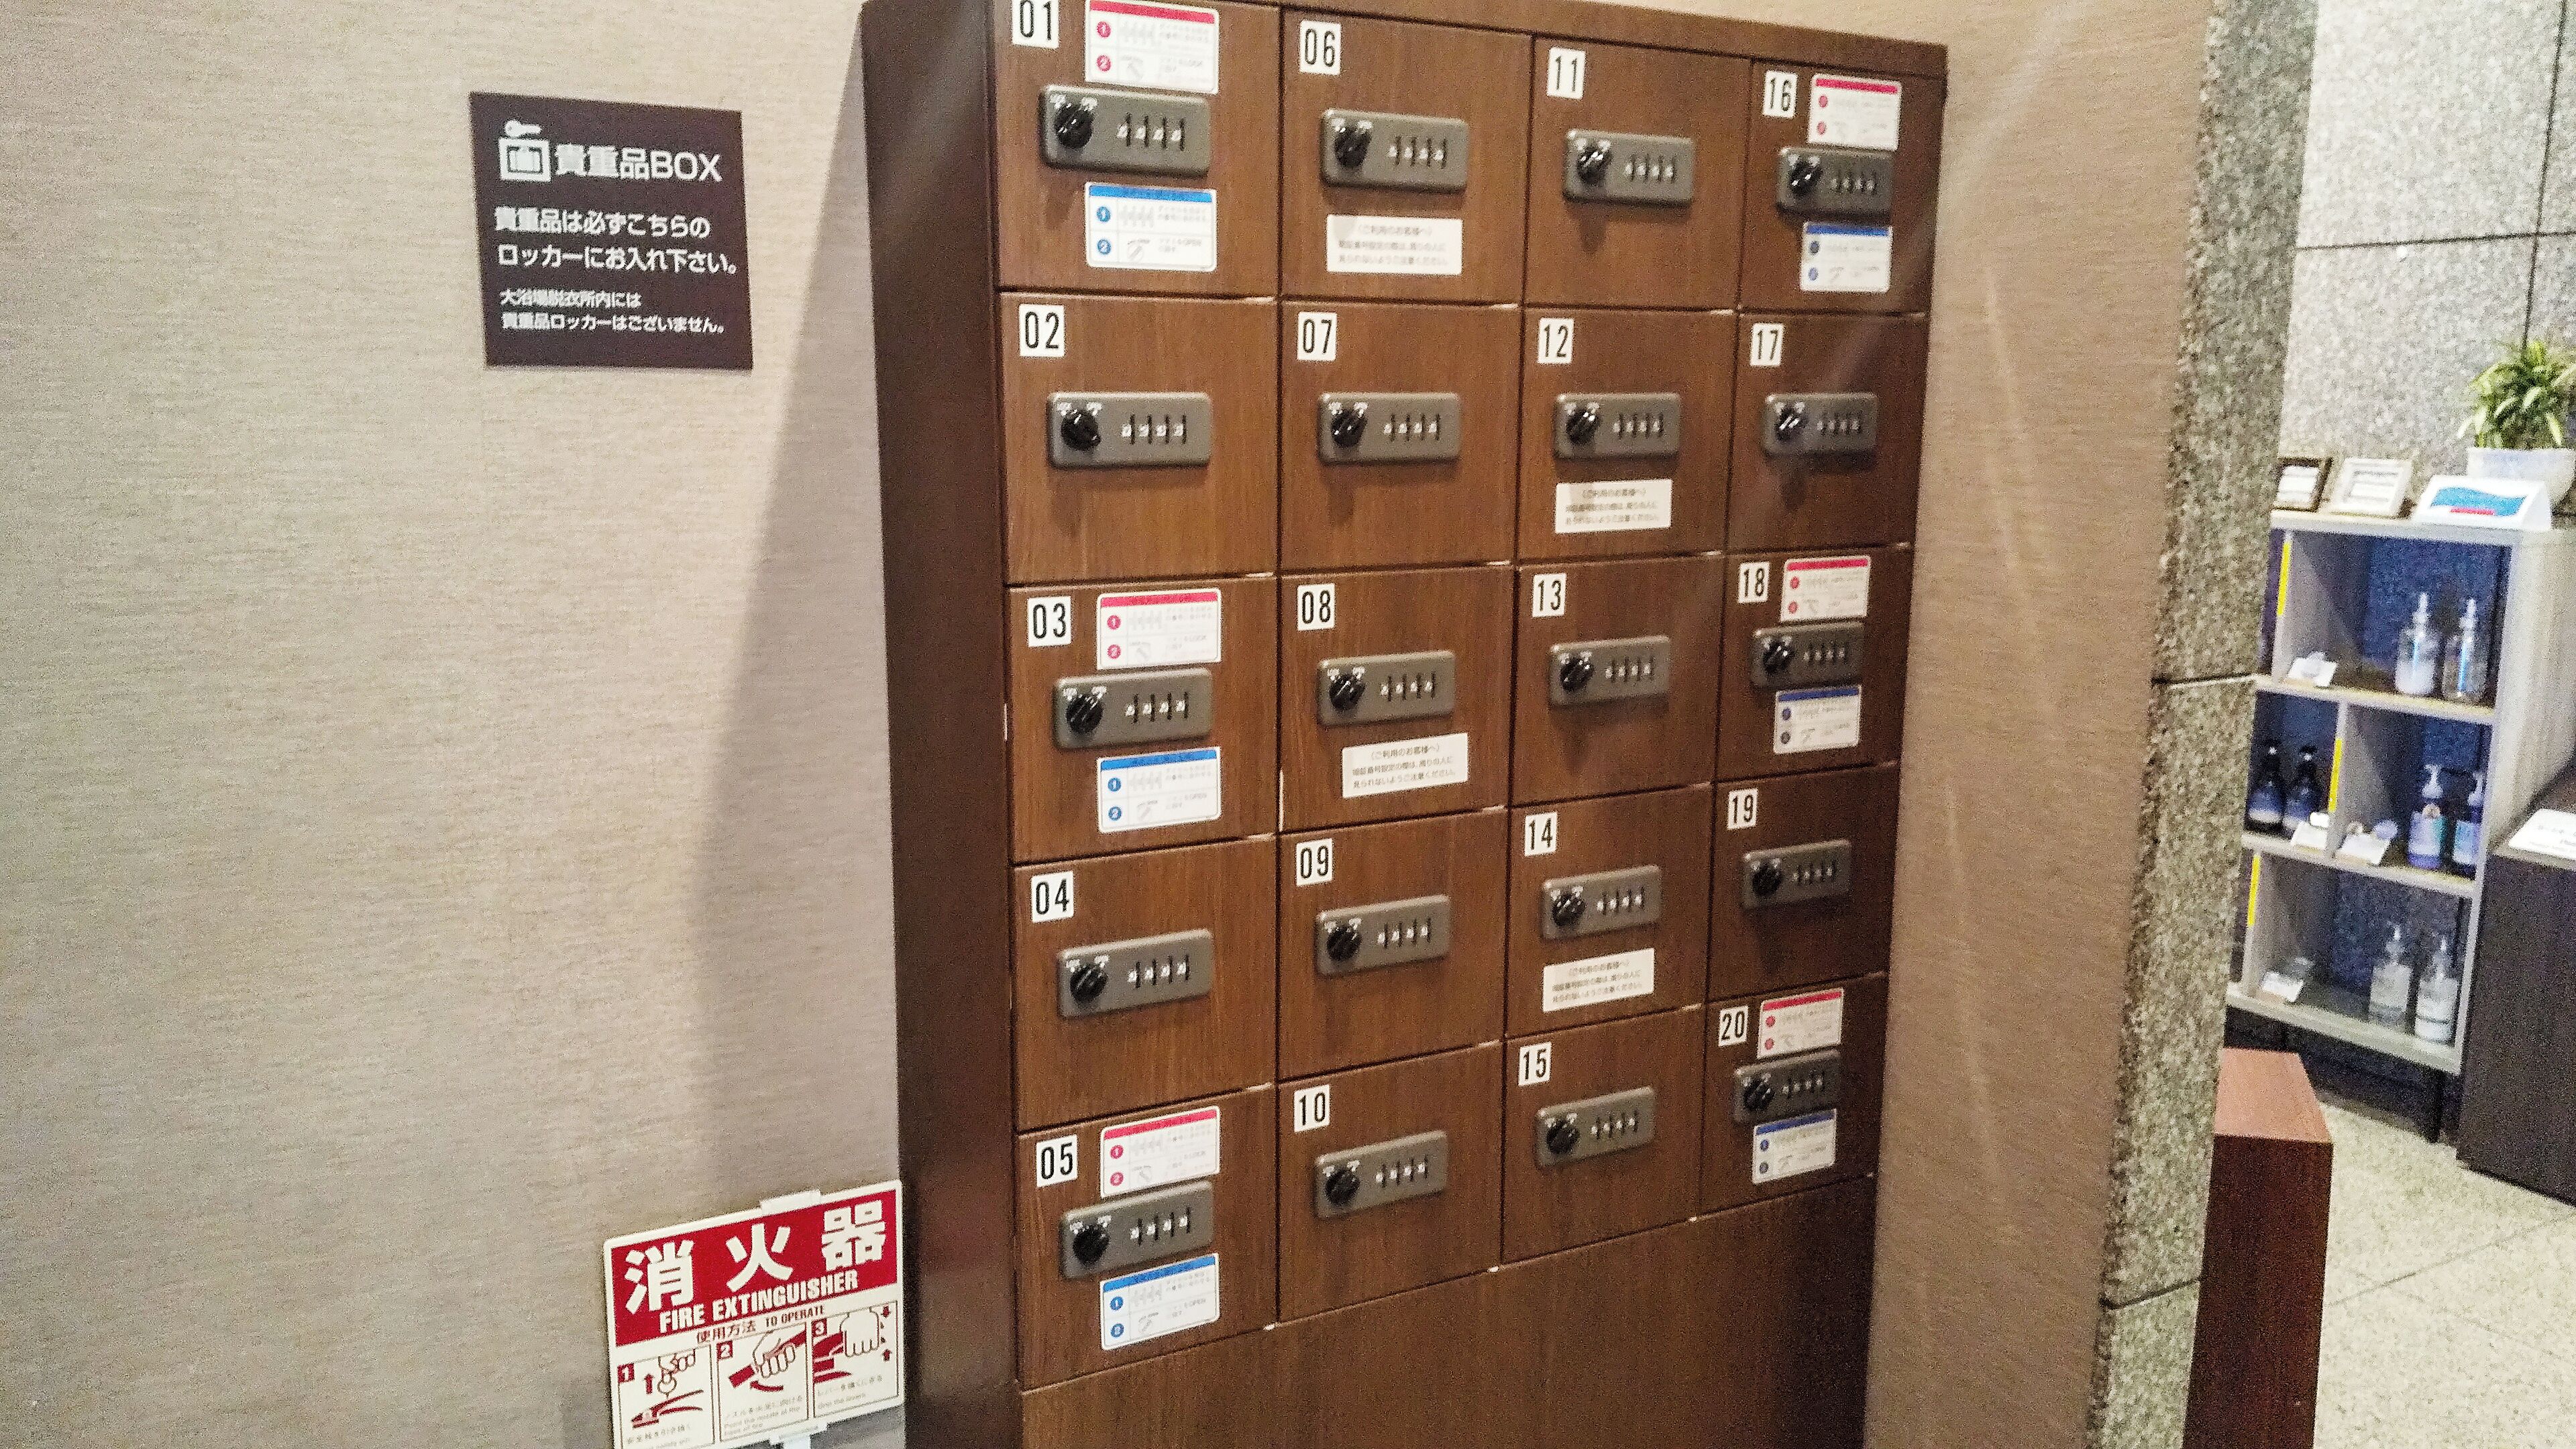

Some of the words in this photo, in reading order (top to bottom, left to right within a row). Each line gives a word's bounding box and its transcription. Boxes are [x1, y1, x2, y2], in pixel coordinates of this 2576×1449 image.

[1020, 0, 1052, 40] 01
[1305, 28, 1335, 66] 06
[1555, 56, 1578, 92] 11
[1769, 76, 1791, 111] 16
[555, 144, 722, 182] 貴重品BOX
[494, 206, 711, 239] 貴重品は必ずこちらの
[498, 244, 737, 274] ロッカーにお入れ下さい。
[501, 312, 723, 334] 貴重品ロッカーはございません。
[1025, 311, 1059, 349] 02
[1303, 319, 1332, 354] 07
[1544, 325, 1568, 358] 12
[1757, 329, 1779, 361] 17
[1538, 580, 1562, 611] 13
[1743, 567, 1765, 597] 18
[1033, 602, 1066, 639] 03
[1302, 590, 1331, 624] 08
[1732, 794, 1754, 824] 19
[1529, 818, 1553, 850] 14
[1300, 845, 1329, 879] 09
[1035, 878, 1070, 915] 04
[1721, 1010, 1746, 1040] 20
[1523, 1049, 1546, 1080] 15
[1299, 1092, 1326, 1126] 10
[1041, 1142, 1073, 1180] 05
[625, 1199, 887, 1313] 消火器
[659, 1305, 705, 1333] FIRE
[713, 1269, 859, 1322] EXTINGUISHER
[766, 1316, 777, 1328] TO
[782, 1305, 824, 1324] OPERATE
[697, 1320, 756, 1343] 使用方法
